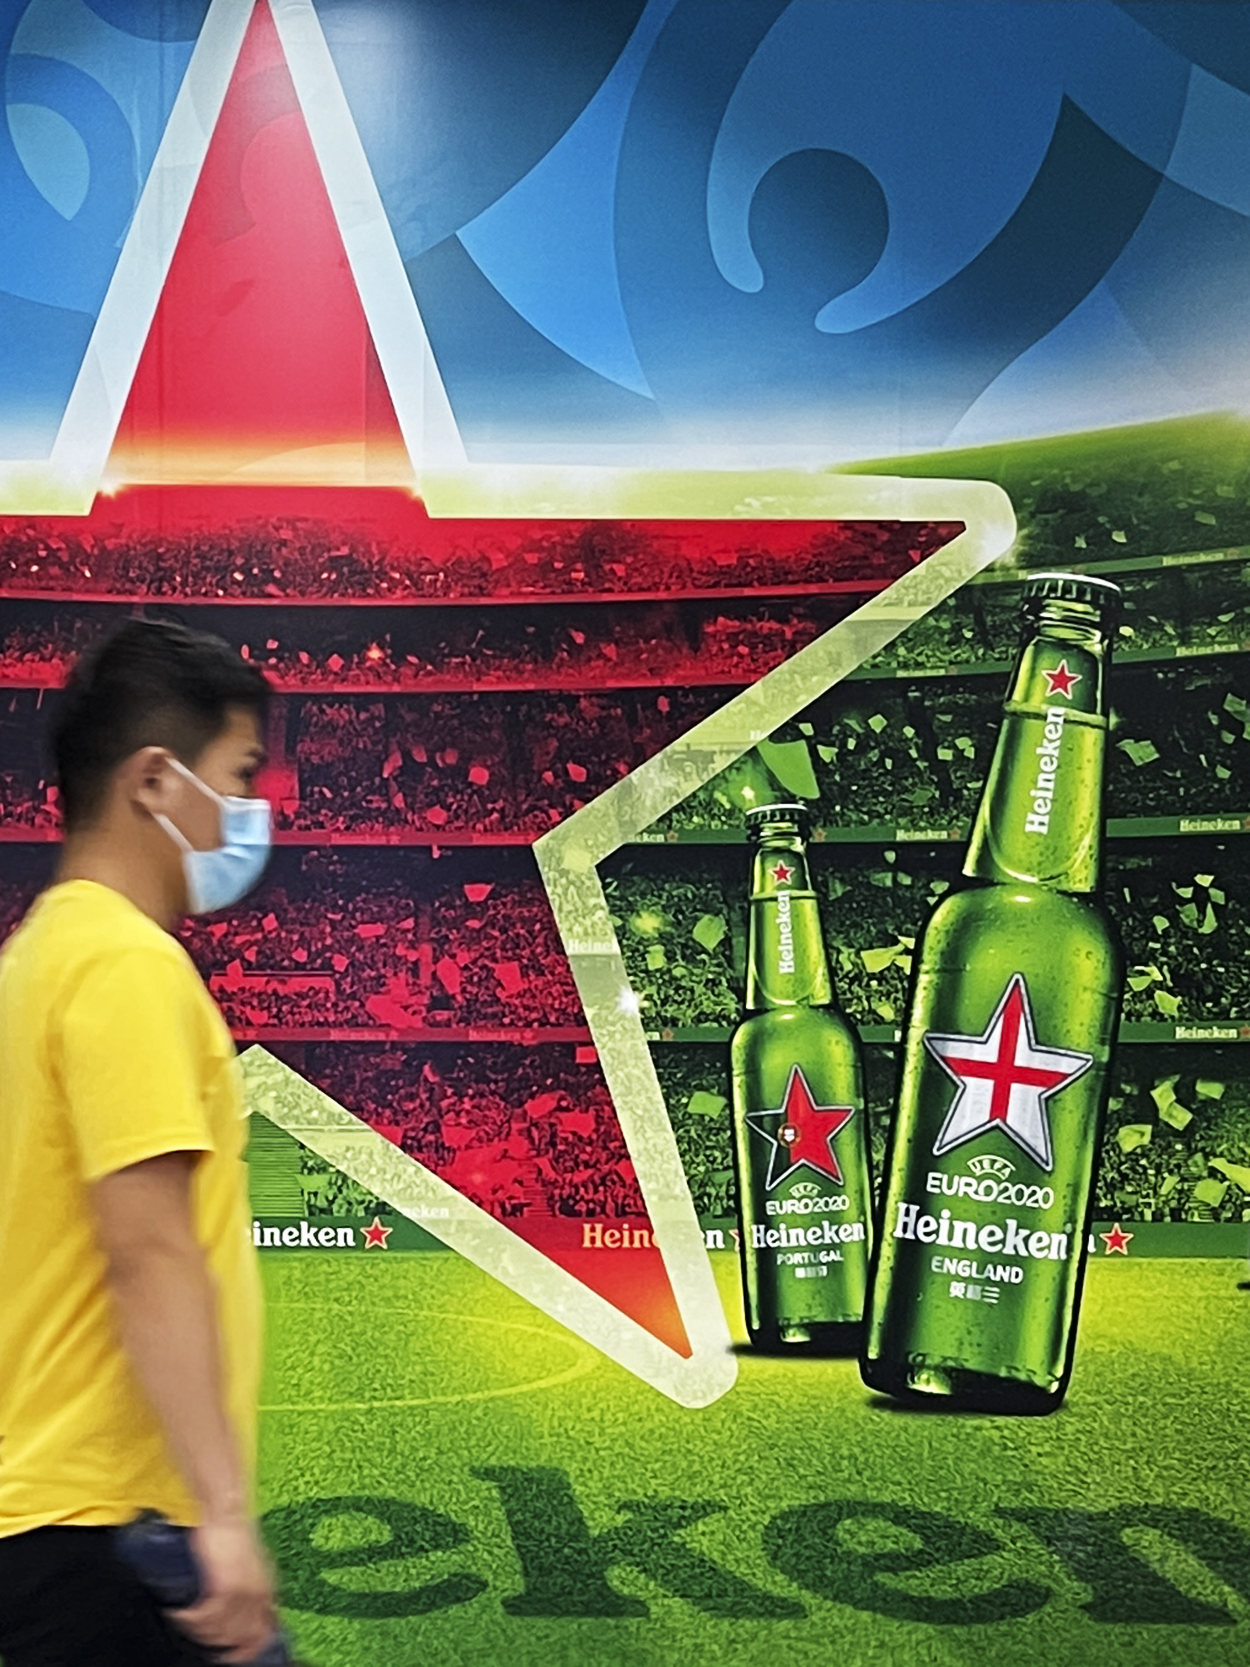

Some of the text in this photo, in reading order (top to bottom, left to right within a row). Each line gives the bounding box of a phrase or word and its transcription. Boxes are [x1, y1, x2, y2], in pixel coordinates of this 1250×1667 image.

[1024, 706, 1067, 836] Heineken
[1179, 818, 1241, 833] Heineken
[774, 890, 796, 975] Heineken
[1174, 1025, 1239, 1040] Heineken
[764, 1195, 850, 1216] EURO2020
[925, 1171, 1056, 1210] EURO2020
[251, 1219, 356, 1248] ineken
[750, 1219, 866, 1249] Heineken
[893, 1202, 1069, 1261] Heineken
[776, 1250, 845, 1266] PORTUGAL
[930, 1255, 1024, 1285] ENGLAND
